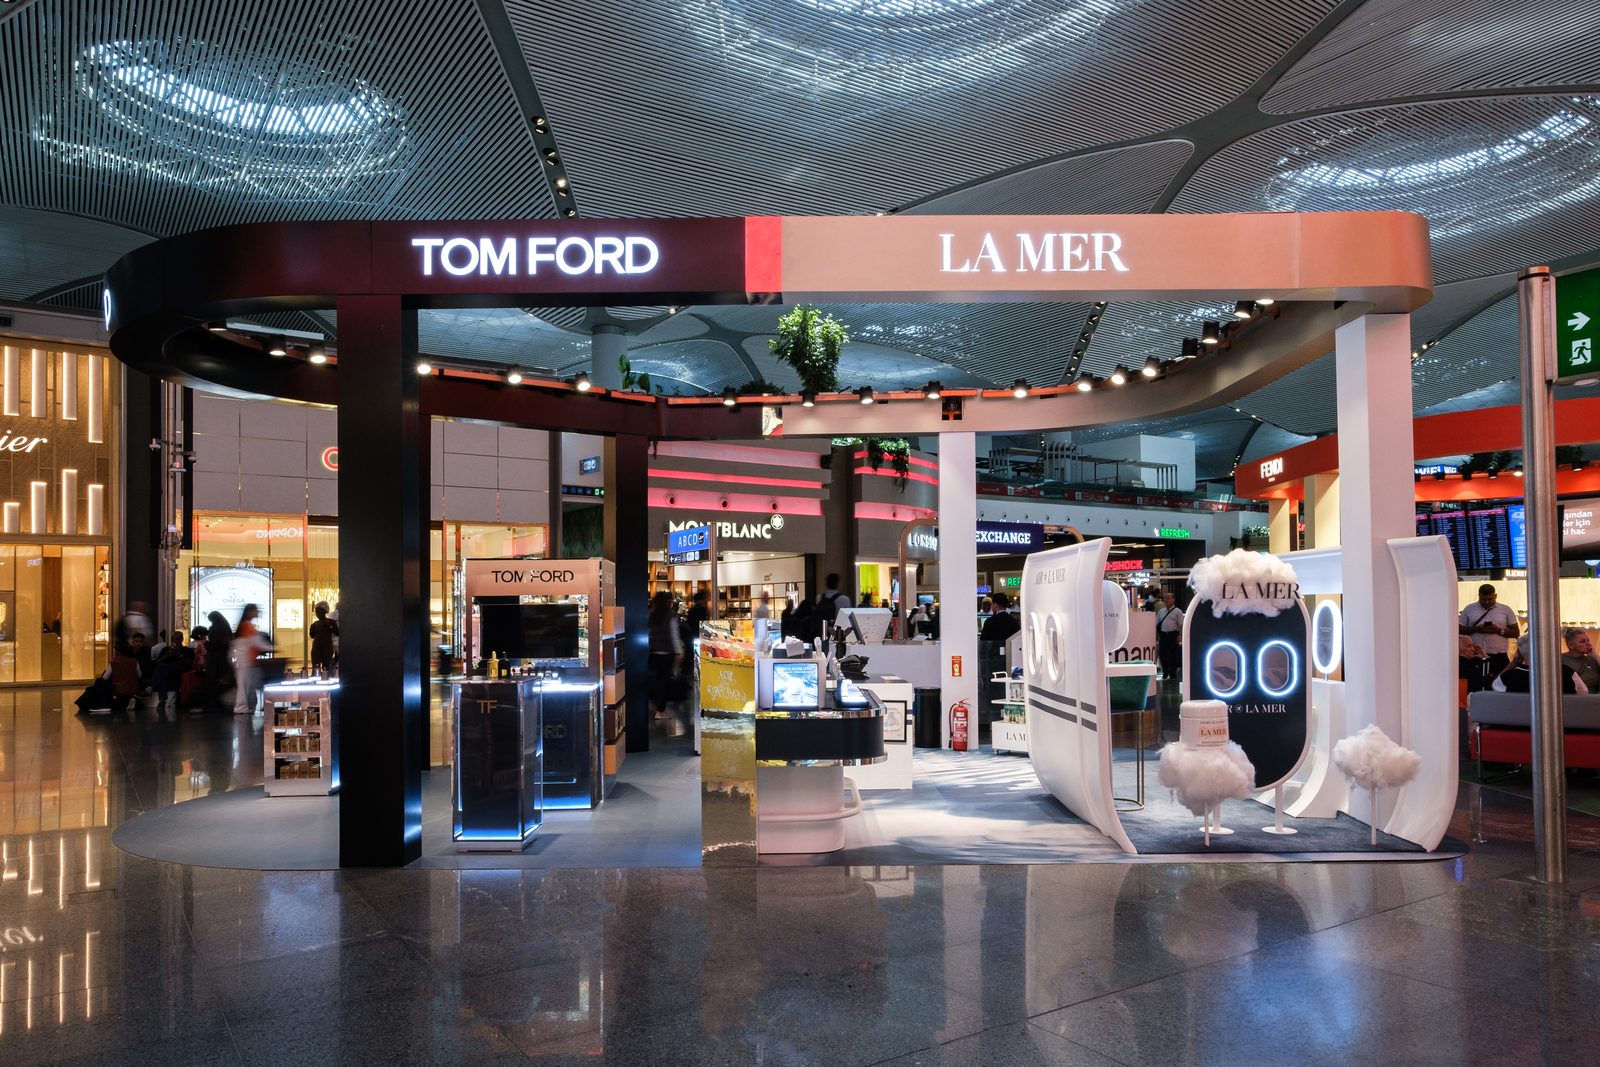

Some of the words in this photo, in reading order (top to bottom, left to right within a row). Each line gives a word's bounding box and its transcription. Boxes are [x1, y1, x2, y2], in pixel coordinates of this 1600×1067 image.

[412, 238, 517, 275] TOM
[528, 236, 659, 275] FORD
[938, 232, 1007, 272] LA
[1016, 232, 1130, 272] MER
[0, 429, 48, 453] ier
[1260, 457, 1283, 479] FENDI
[669, 519, 772, 539] MOTBLANC
[975, 530, 1031, 545] EXCHANGE
[1160, 528, 1191, 539] REFRESH
[491, 570, 526, 583] TOM
[530, 570, 574, 583] FORD
[1222, 582, 1249, 599] LA
[1255, 582, 1303, 600] MER
[476, 699, 498, 714] TF
[1245, 704, 1260, 714] LA
[1262, 703, 1286, 713] MER
